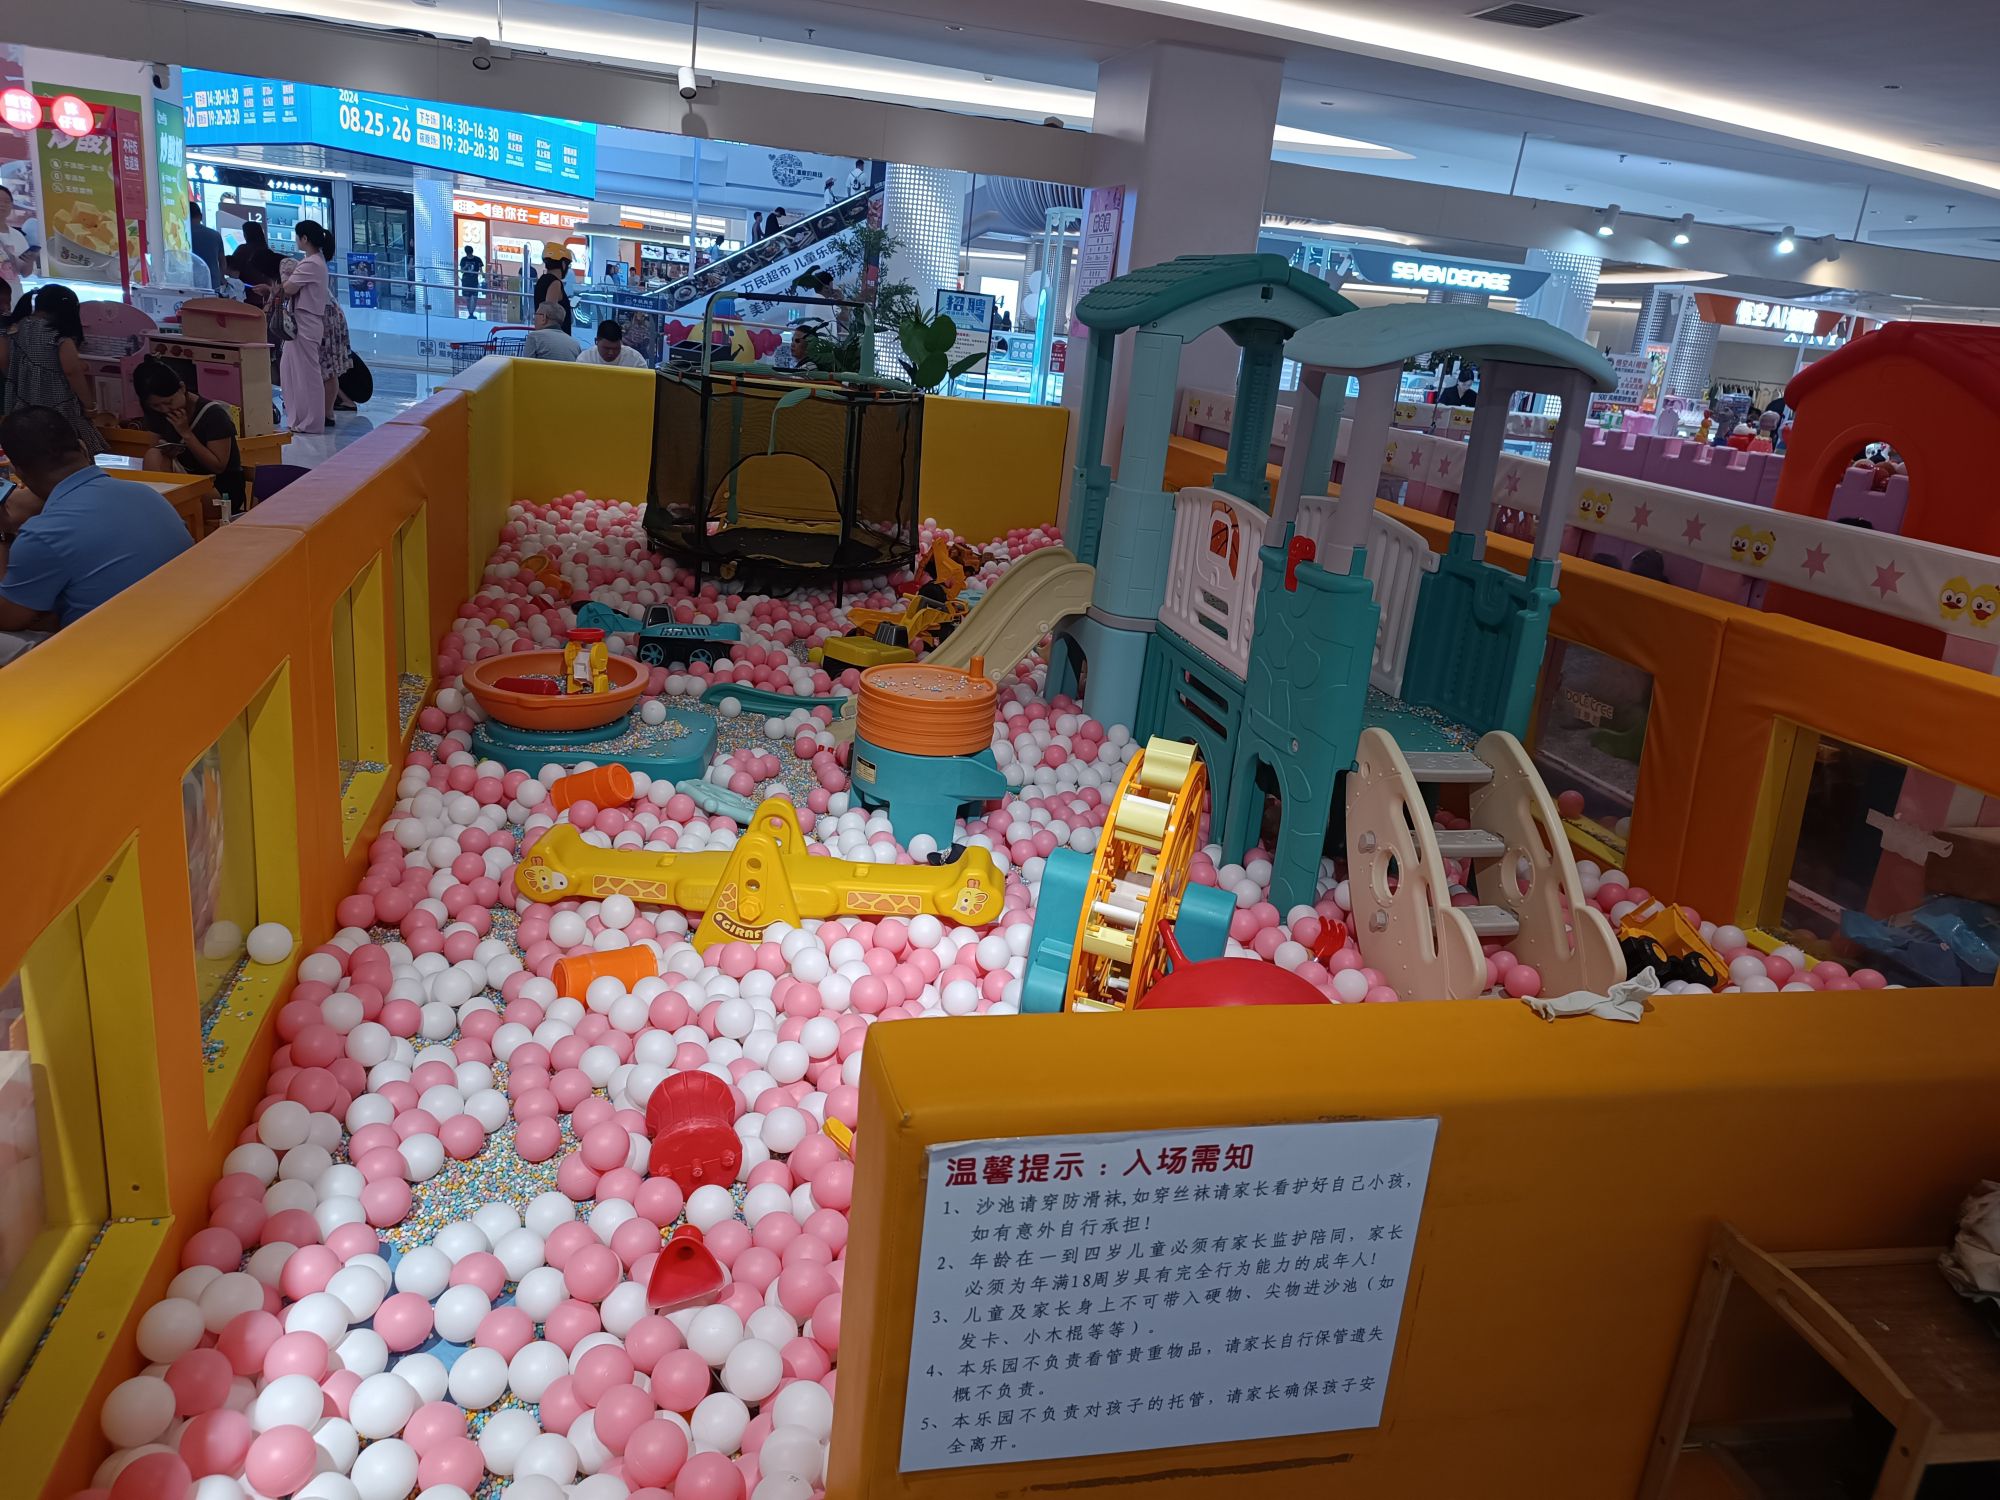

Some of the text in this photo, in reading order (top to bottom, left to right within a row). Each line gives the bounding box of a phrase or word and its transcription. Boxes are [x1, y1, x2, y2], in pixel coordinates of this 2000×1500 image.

[338, 89, 359, 105] 2024
[339, 104, 384, 137] 08.25
[441, 114, 499, 143] 14:30-16:30
[441, 134, 499, 161] 19:20-20:30
[248, 211, 263, 223] L2
[1392, 261, 1511, 291] SEVEN DEGREE
[721, 919, 762, 939] GIRAF
[945, 1143, 1254, 1187] 温馨提示：入场需知
[971, 1216, 1151, 1243] 如有意外自行承担!
[952, 1381, 1044, 1403] 概不负责。
[947, 1435, 1016, 1454] 全离开。
